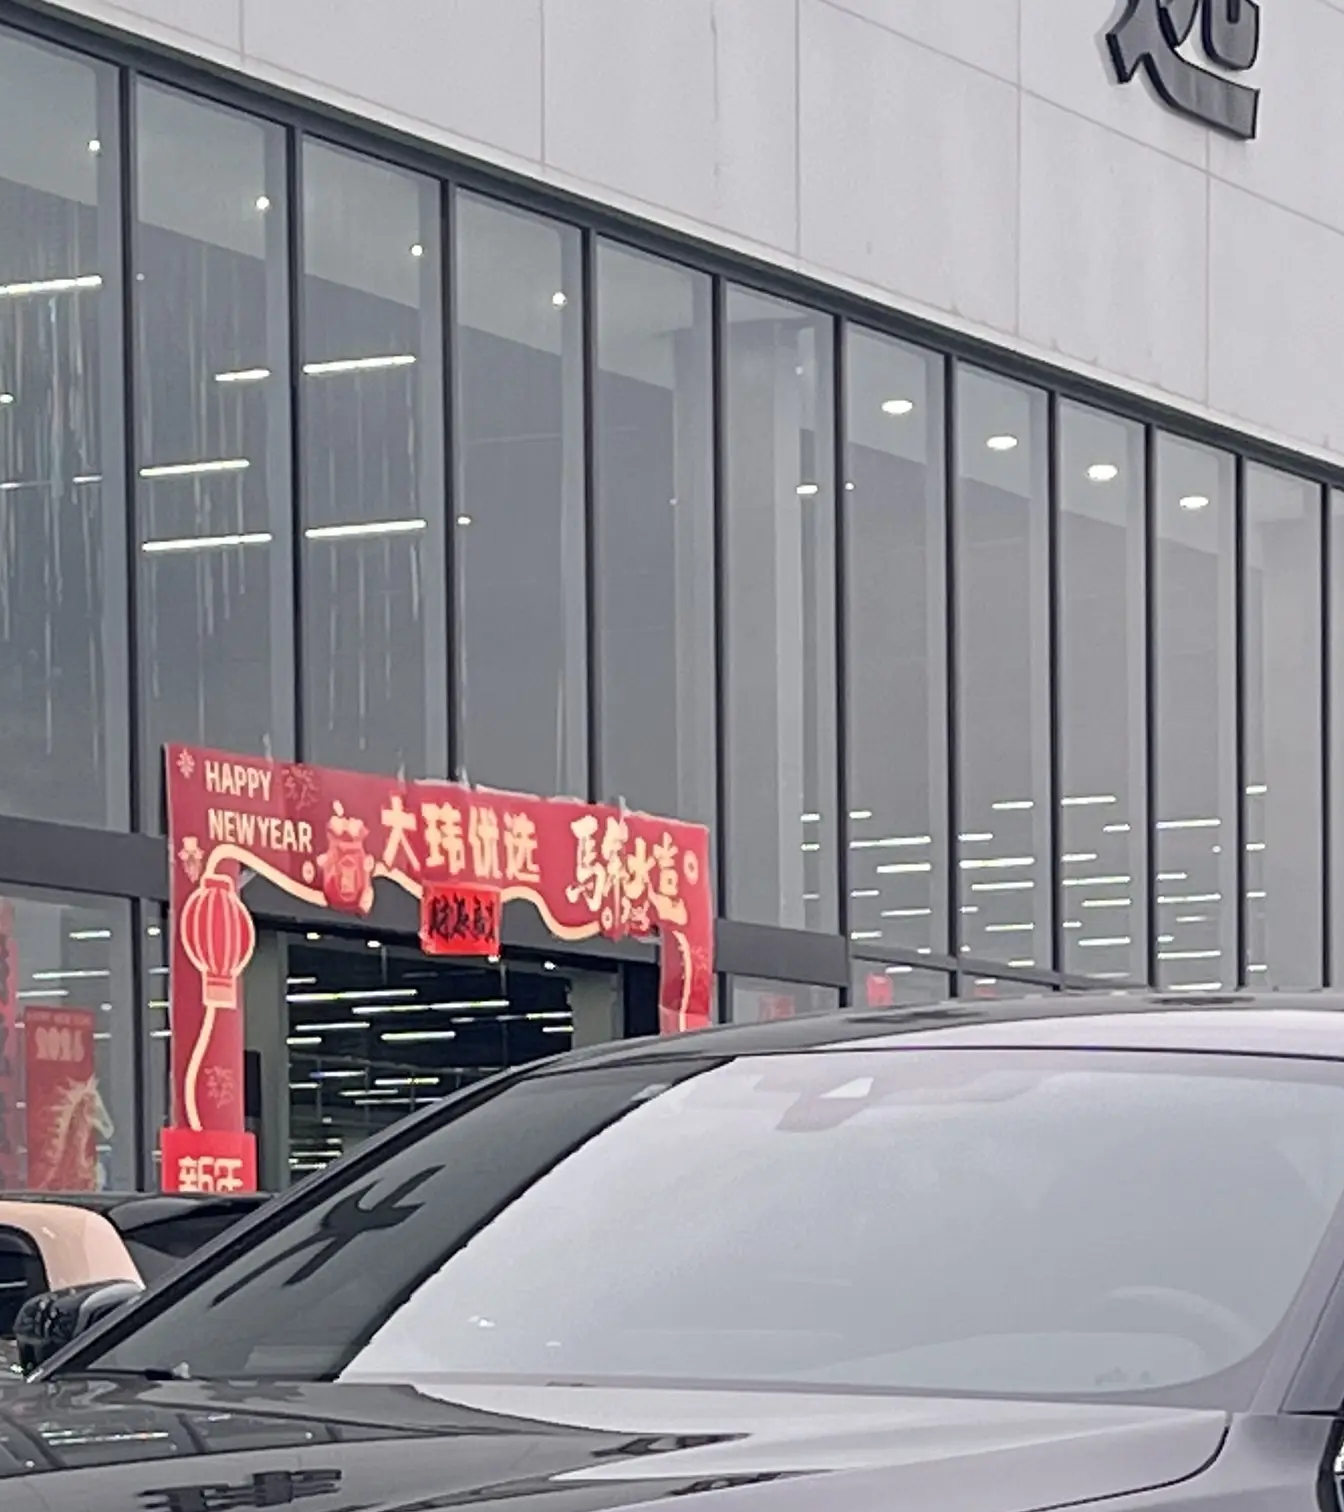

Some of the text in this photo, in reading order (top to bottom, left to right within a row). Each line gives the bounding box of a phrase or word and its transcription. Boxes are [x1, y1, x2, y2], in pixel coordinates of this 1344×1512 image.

[204, 759, 272, 801] HAPPY
[208, 807, 312, 853] NEW YEAR
[381, 795, 541, 883] 大玮优选
